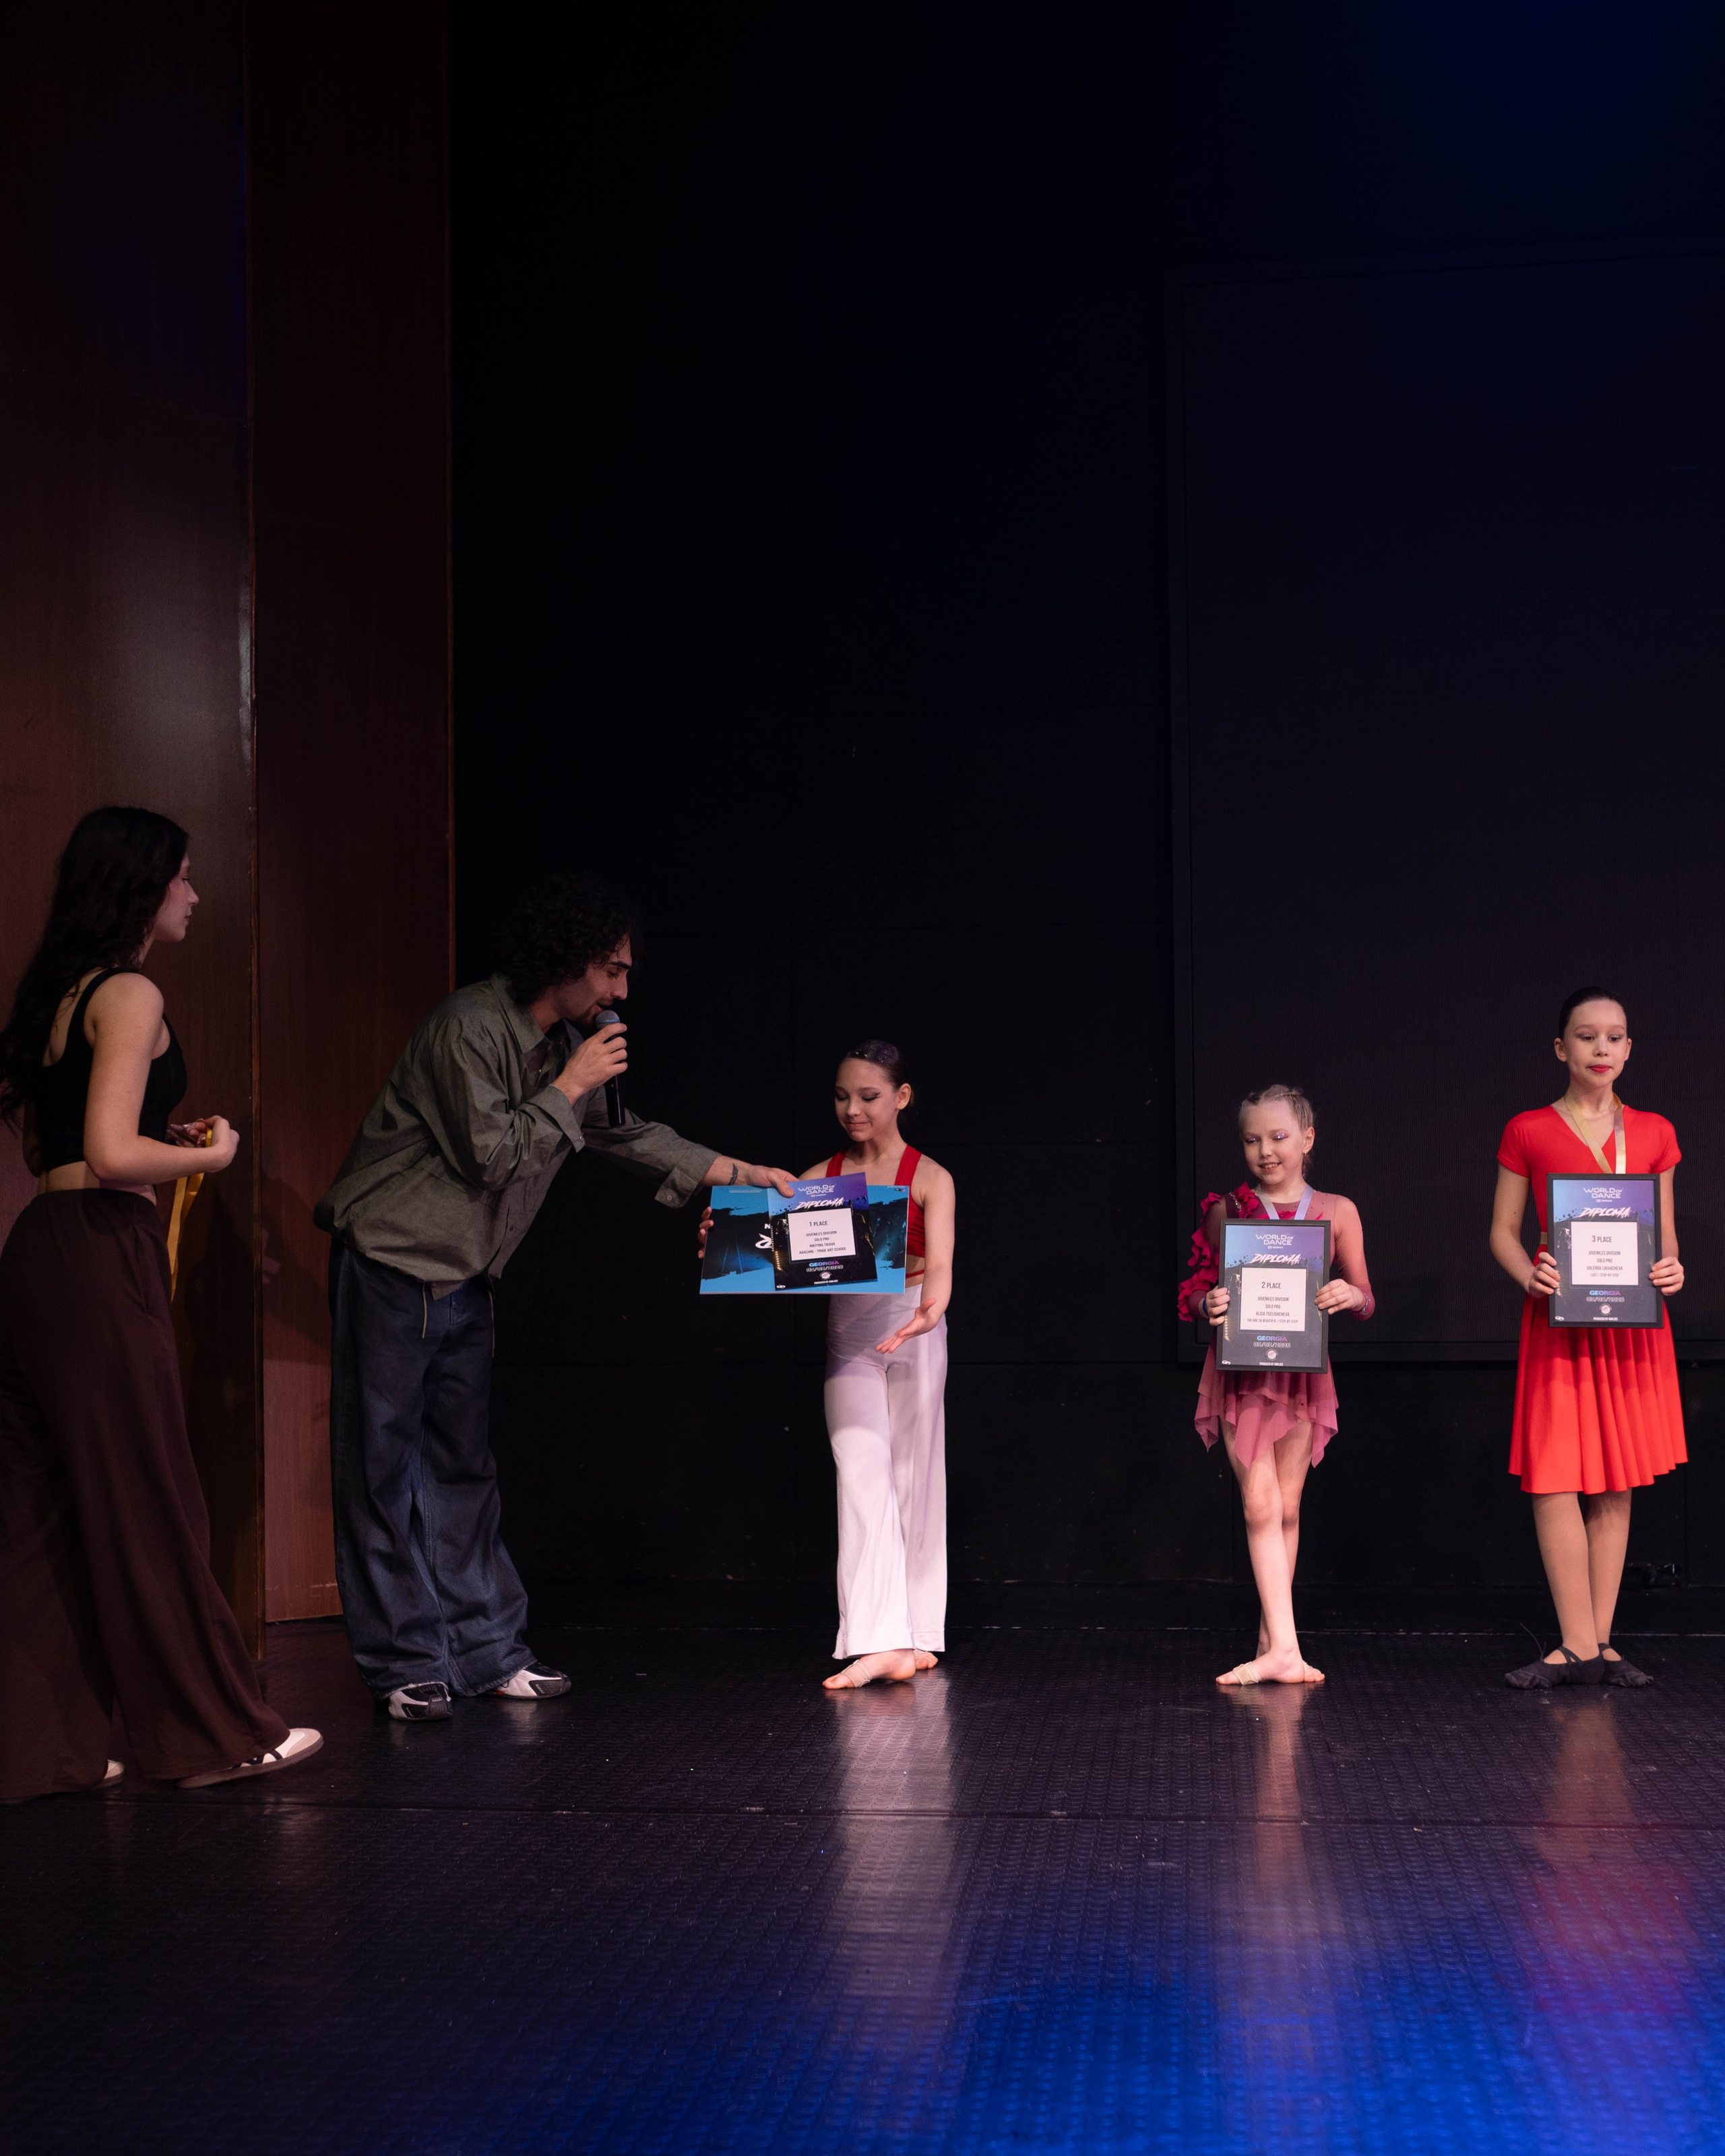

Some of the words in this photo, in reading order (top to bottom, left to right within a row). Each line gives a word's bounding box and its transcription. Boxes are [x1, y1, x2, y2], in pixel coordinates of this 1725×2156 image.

[792, 1197, 844, 1211] DIPLOMA
[1575, 1207, 1631, 1218] DIPLOMA
[1246, 1253, 1301, 1265] DIPLOMA
